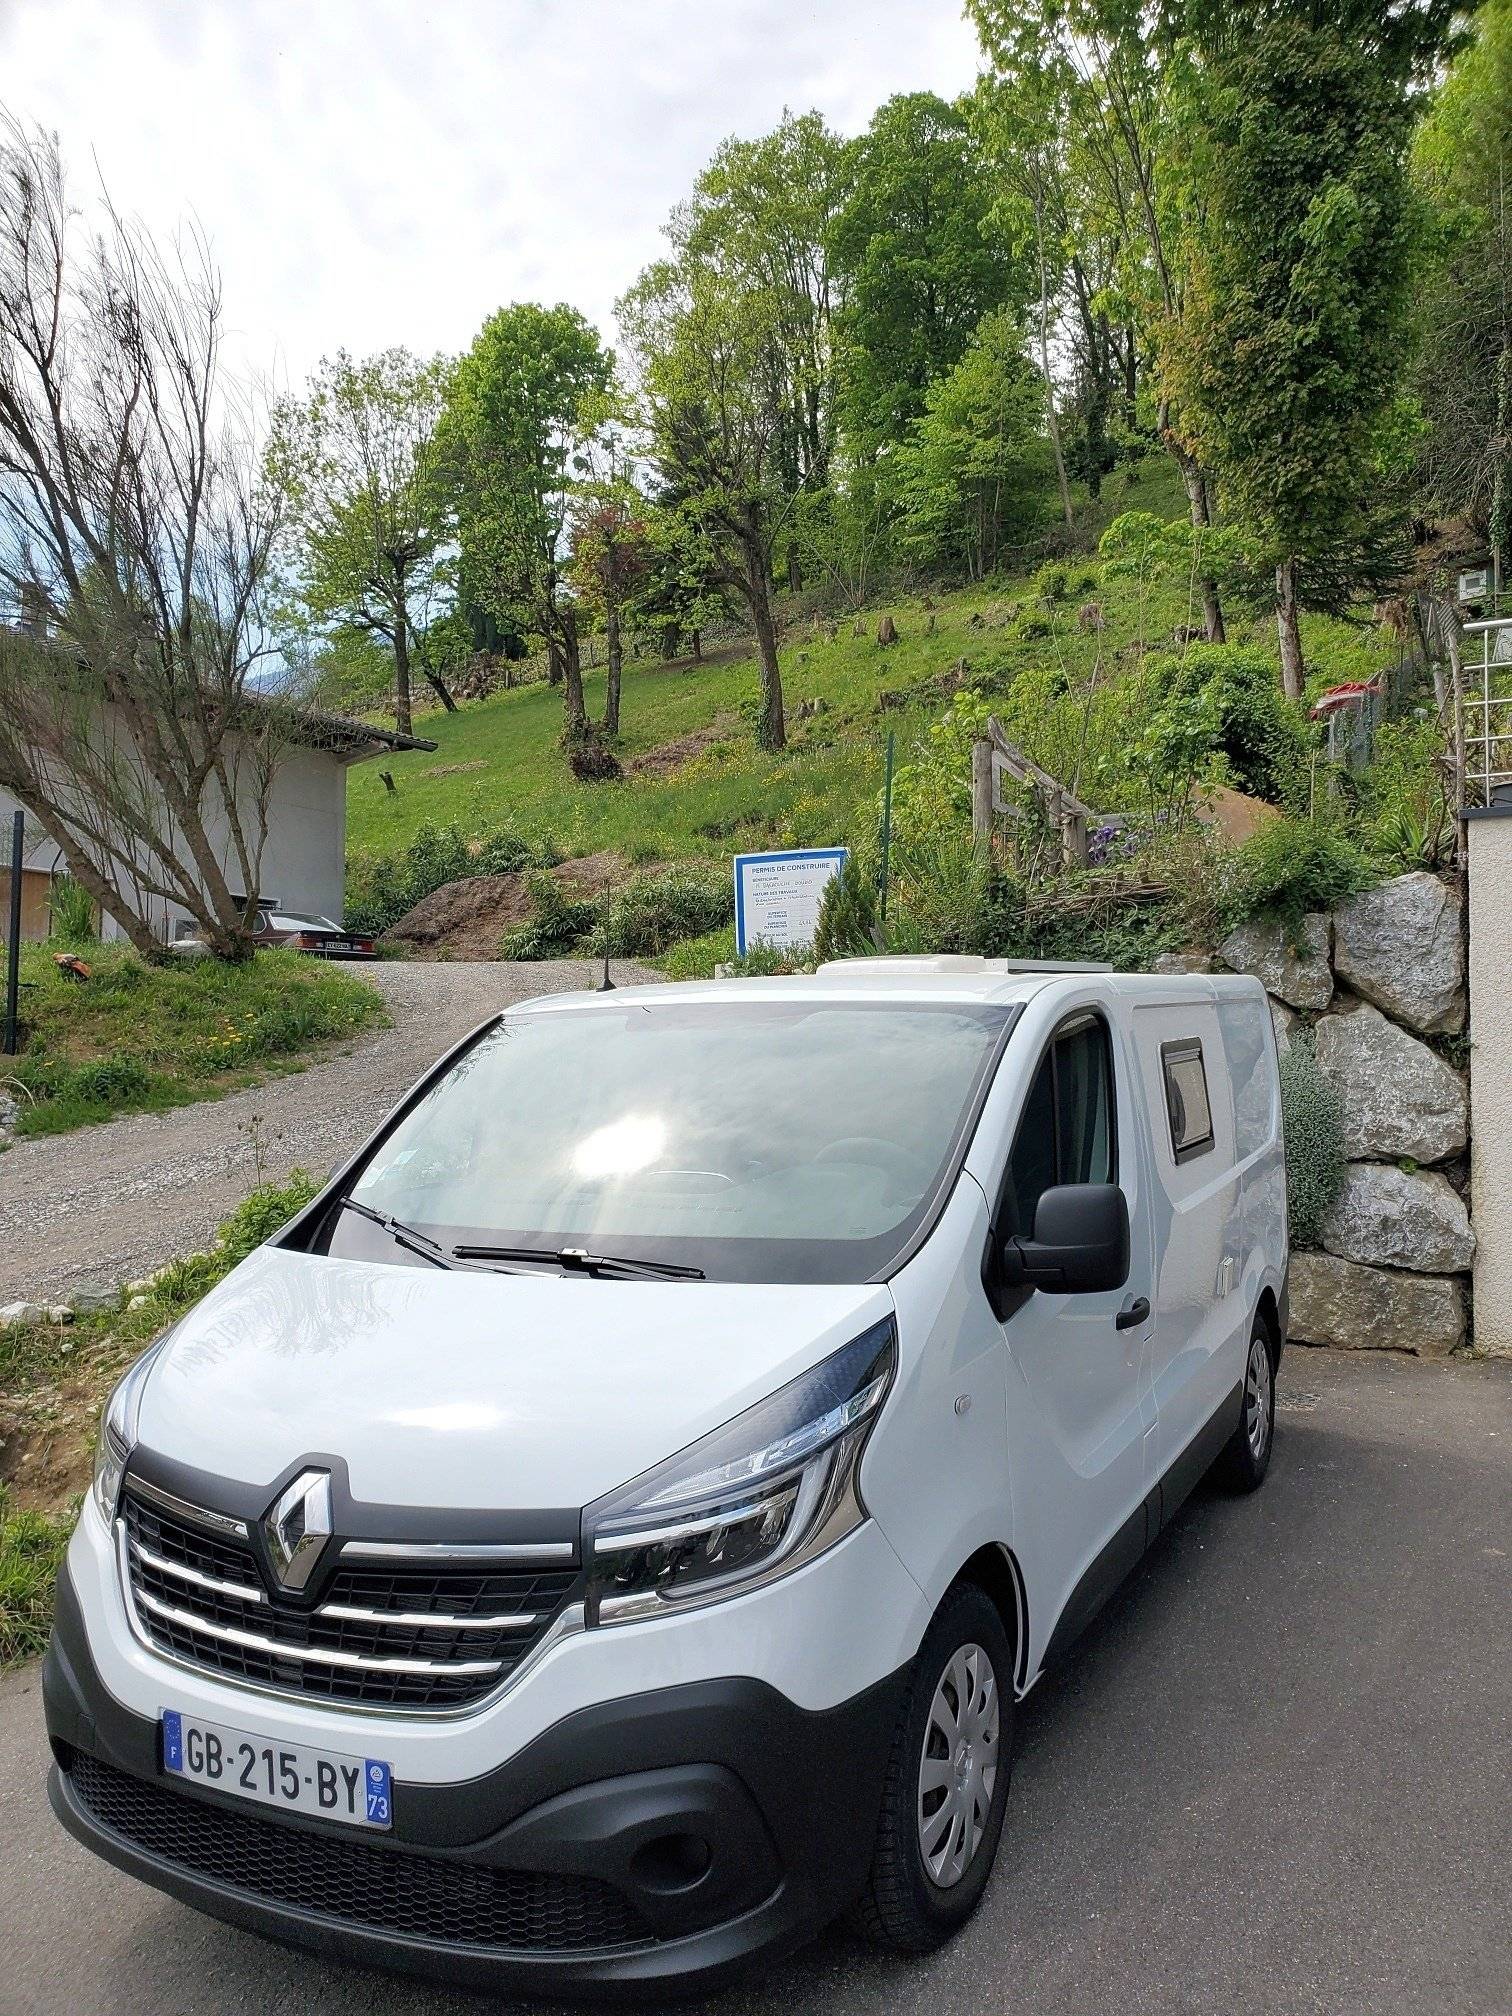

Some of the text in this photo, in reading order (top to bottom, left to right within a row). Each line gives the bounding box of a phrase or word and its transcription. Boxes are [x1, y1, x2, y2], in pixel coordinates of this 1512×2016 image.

[752, 866, 776, 874] PERMIS
[787, 862, 830, 871] CONSTRUIRE
[170, 1746, 177, 1759] F
[187, 1728, 360, 1814] GB-215-BY
[367, 1794, 388, 1819] 73
